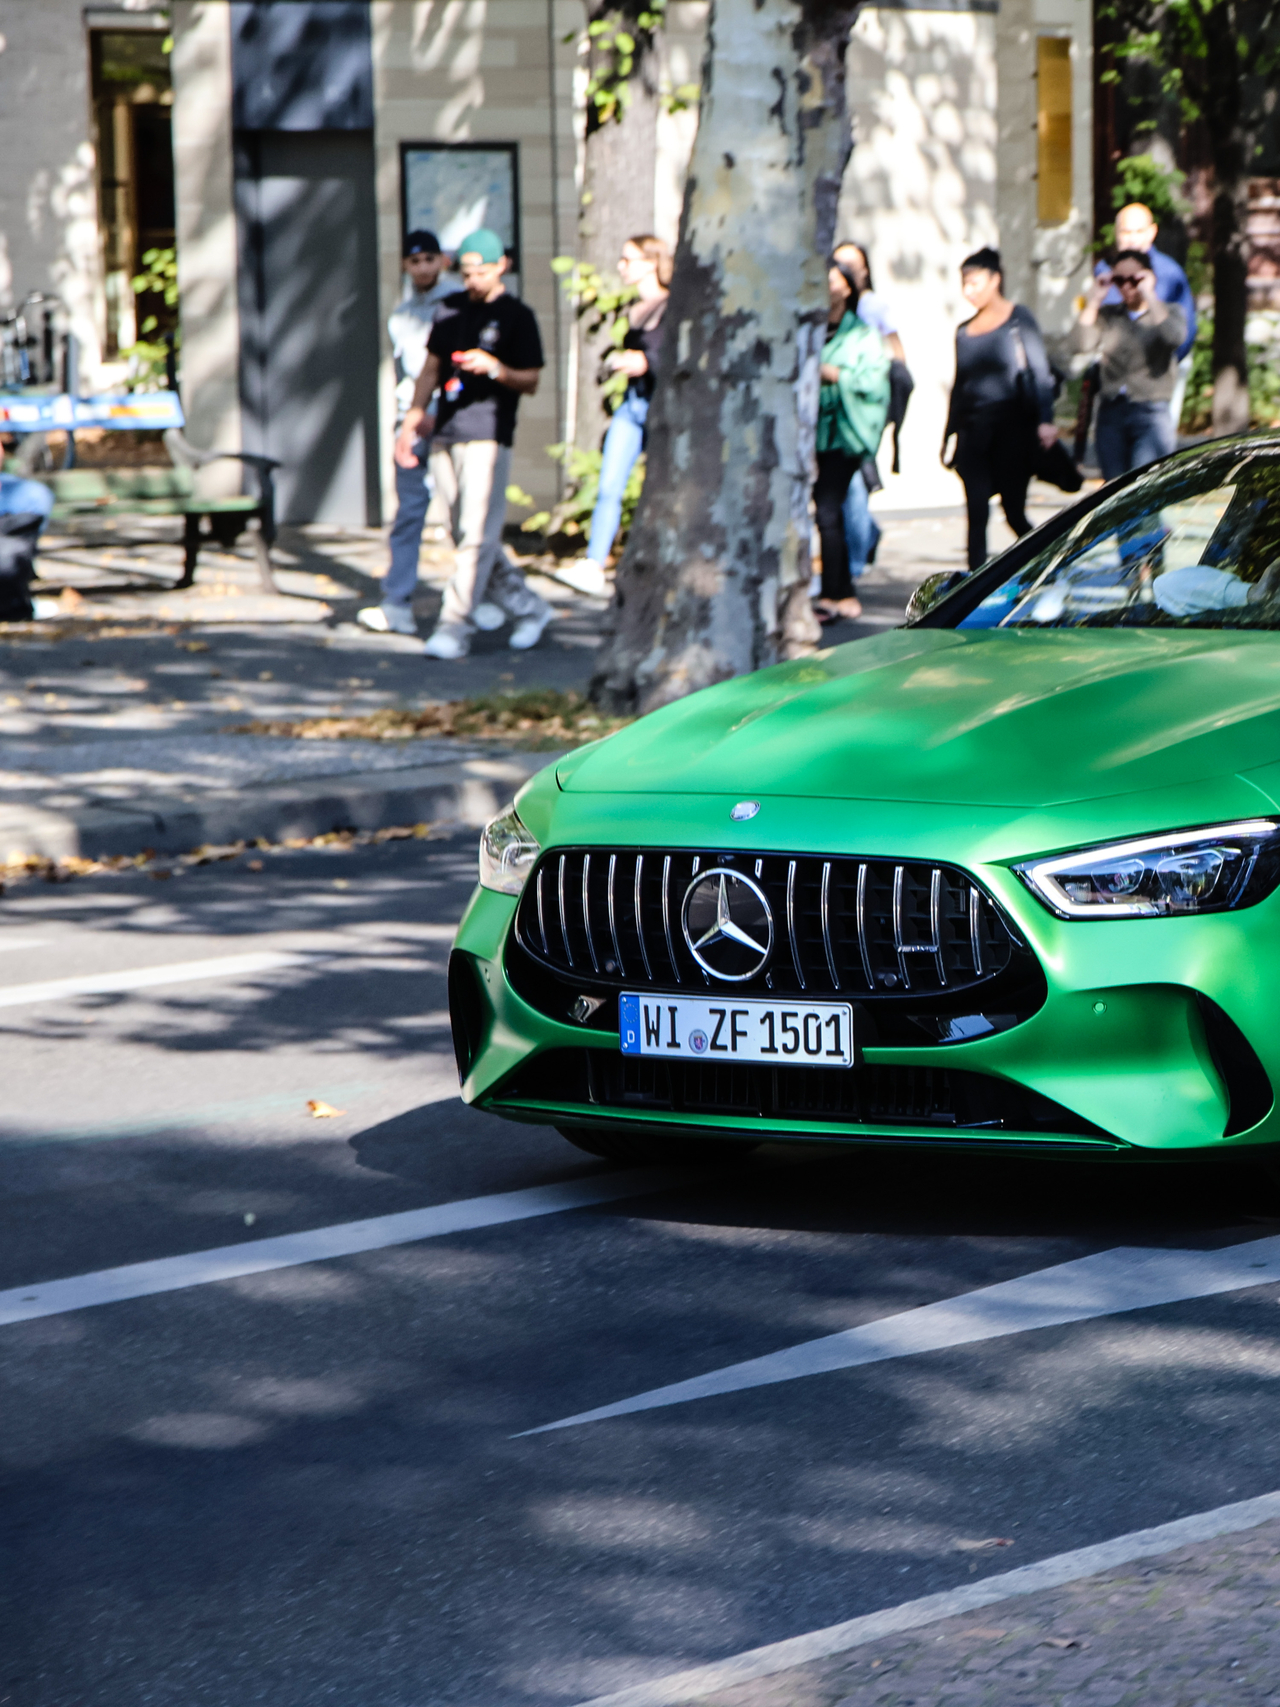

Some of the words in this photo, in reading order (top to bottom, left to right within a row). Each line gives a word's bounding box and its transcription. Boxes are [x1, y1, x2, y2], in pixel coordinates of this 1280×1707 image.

[627, 1030, 635, 1043] D
[643, 1004, 681, 1048] WI
[708, 1008, 750, 1052] ZF
[760, 1010, 845, 1056] 1501
